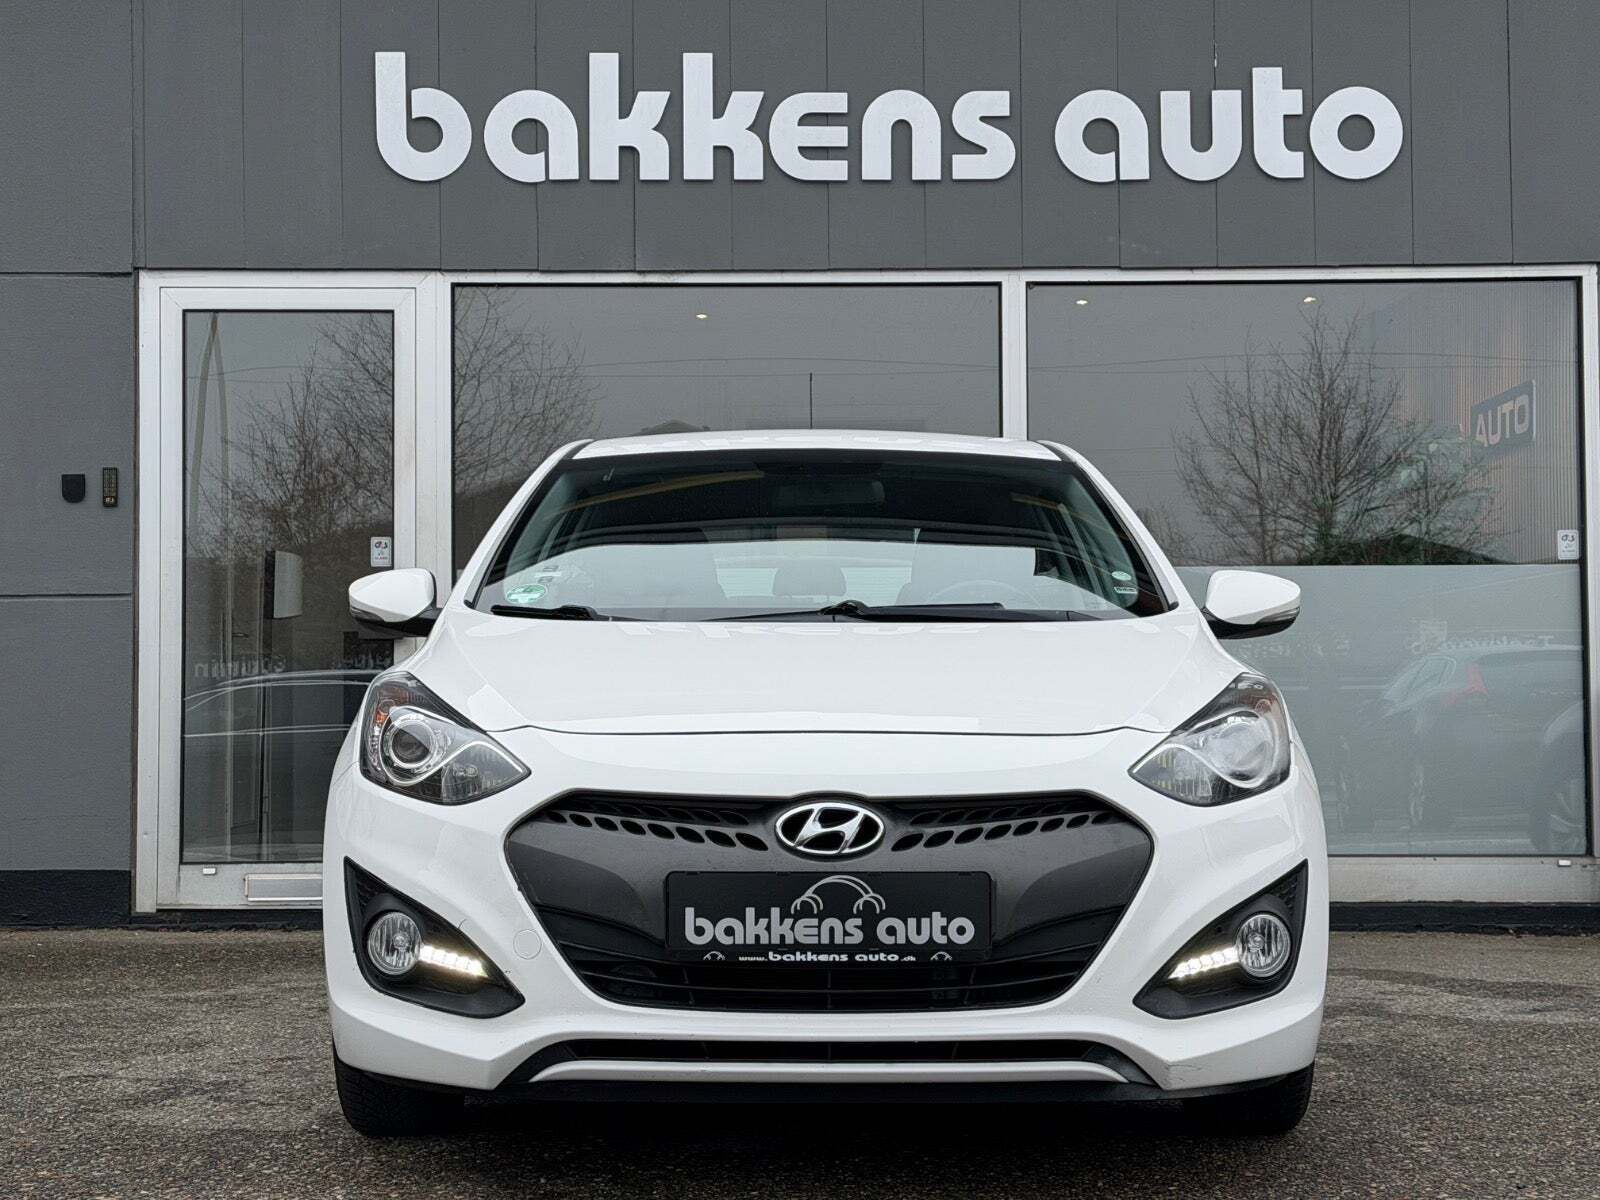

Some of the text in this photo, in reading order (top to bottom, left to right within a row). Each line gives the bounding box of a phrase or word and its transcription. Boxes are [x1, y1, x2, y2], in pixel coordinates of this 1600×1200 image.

[374, 51, 1404, 183] bakkens auto
[1473, 394, 1530, 448] AUTO
[684, 906, 975, 945] bakkens auto
